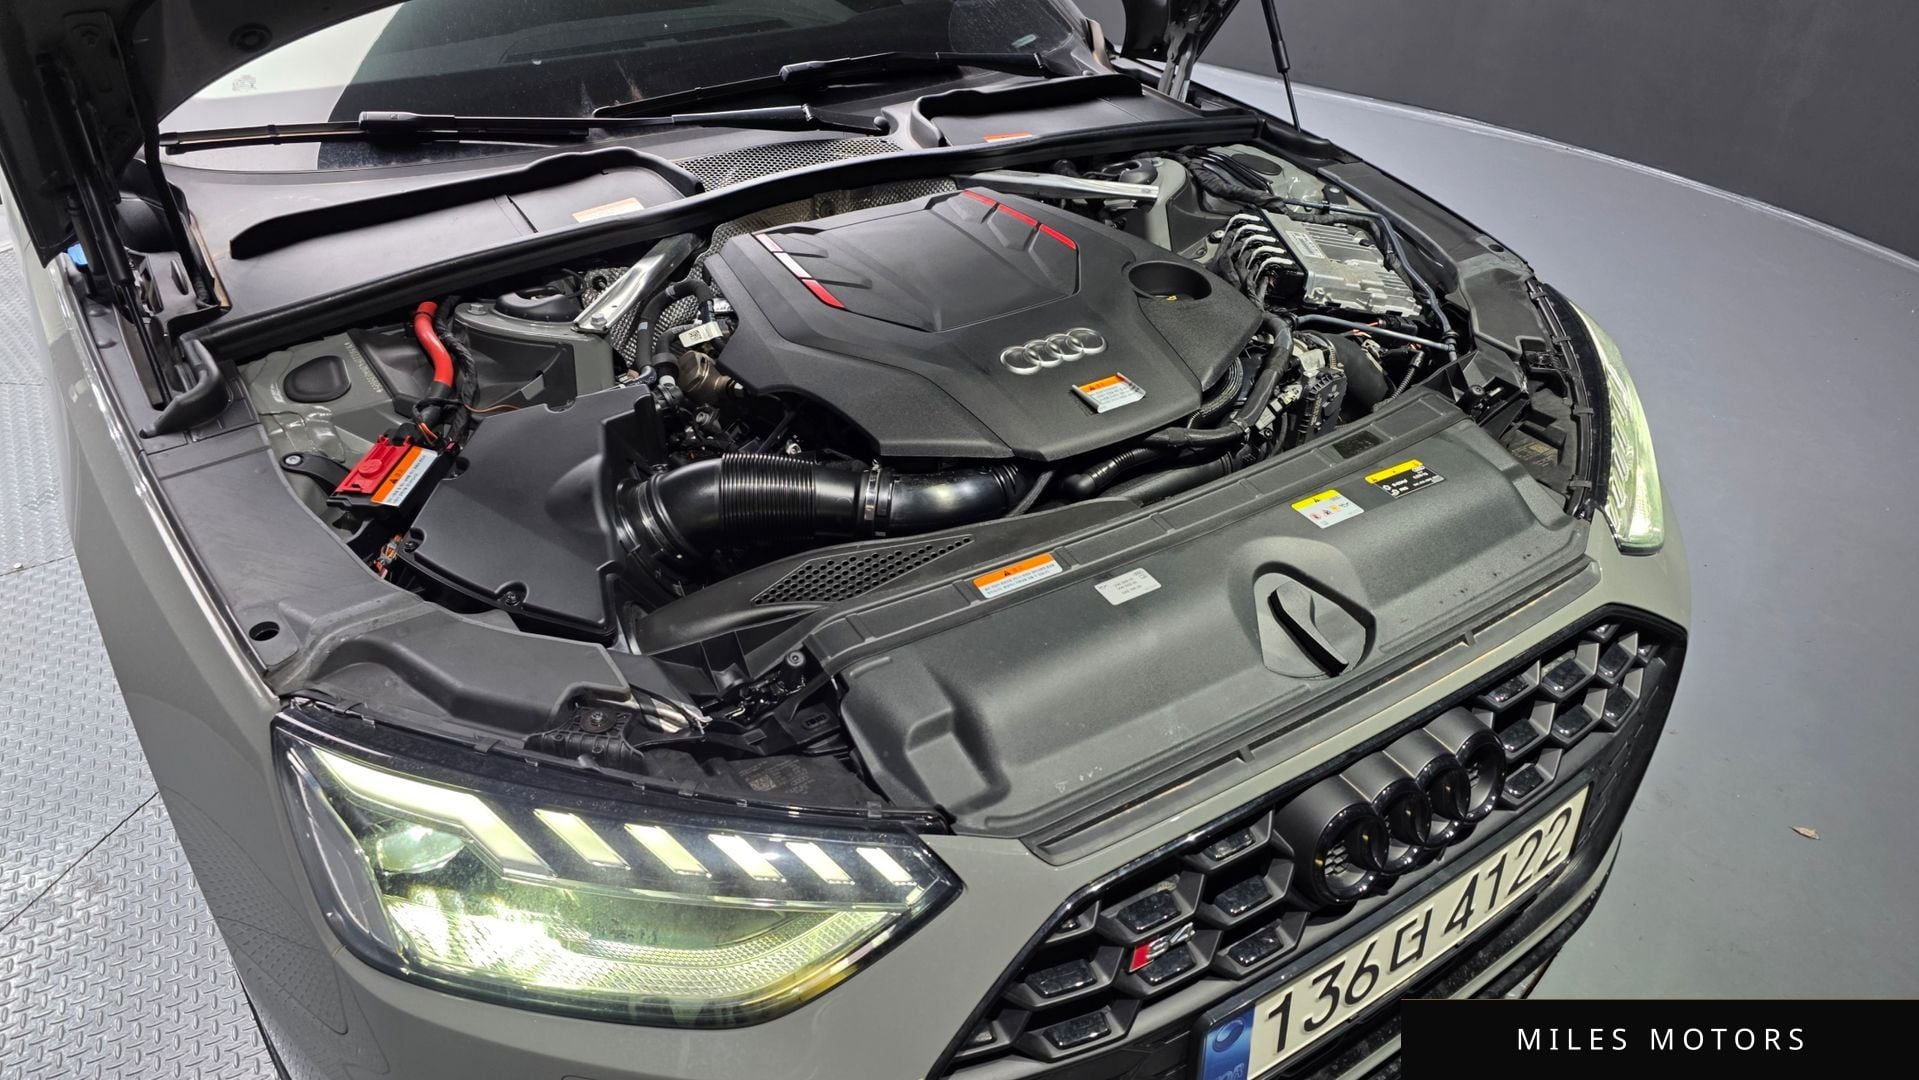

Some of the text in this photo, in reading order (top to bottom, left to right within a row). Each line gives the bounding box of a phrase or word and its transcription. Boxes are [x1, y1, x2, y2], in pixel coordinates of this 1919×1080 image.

[1145, 921, 1196, 961] S4
[1267, 806, 1574, 1054] 136더 4122
